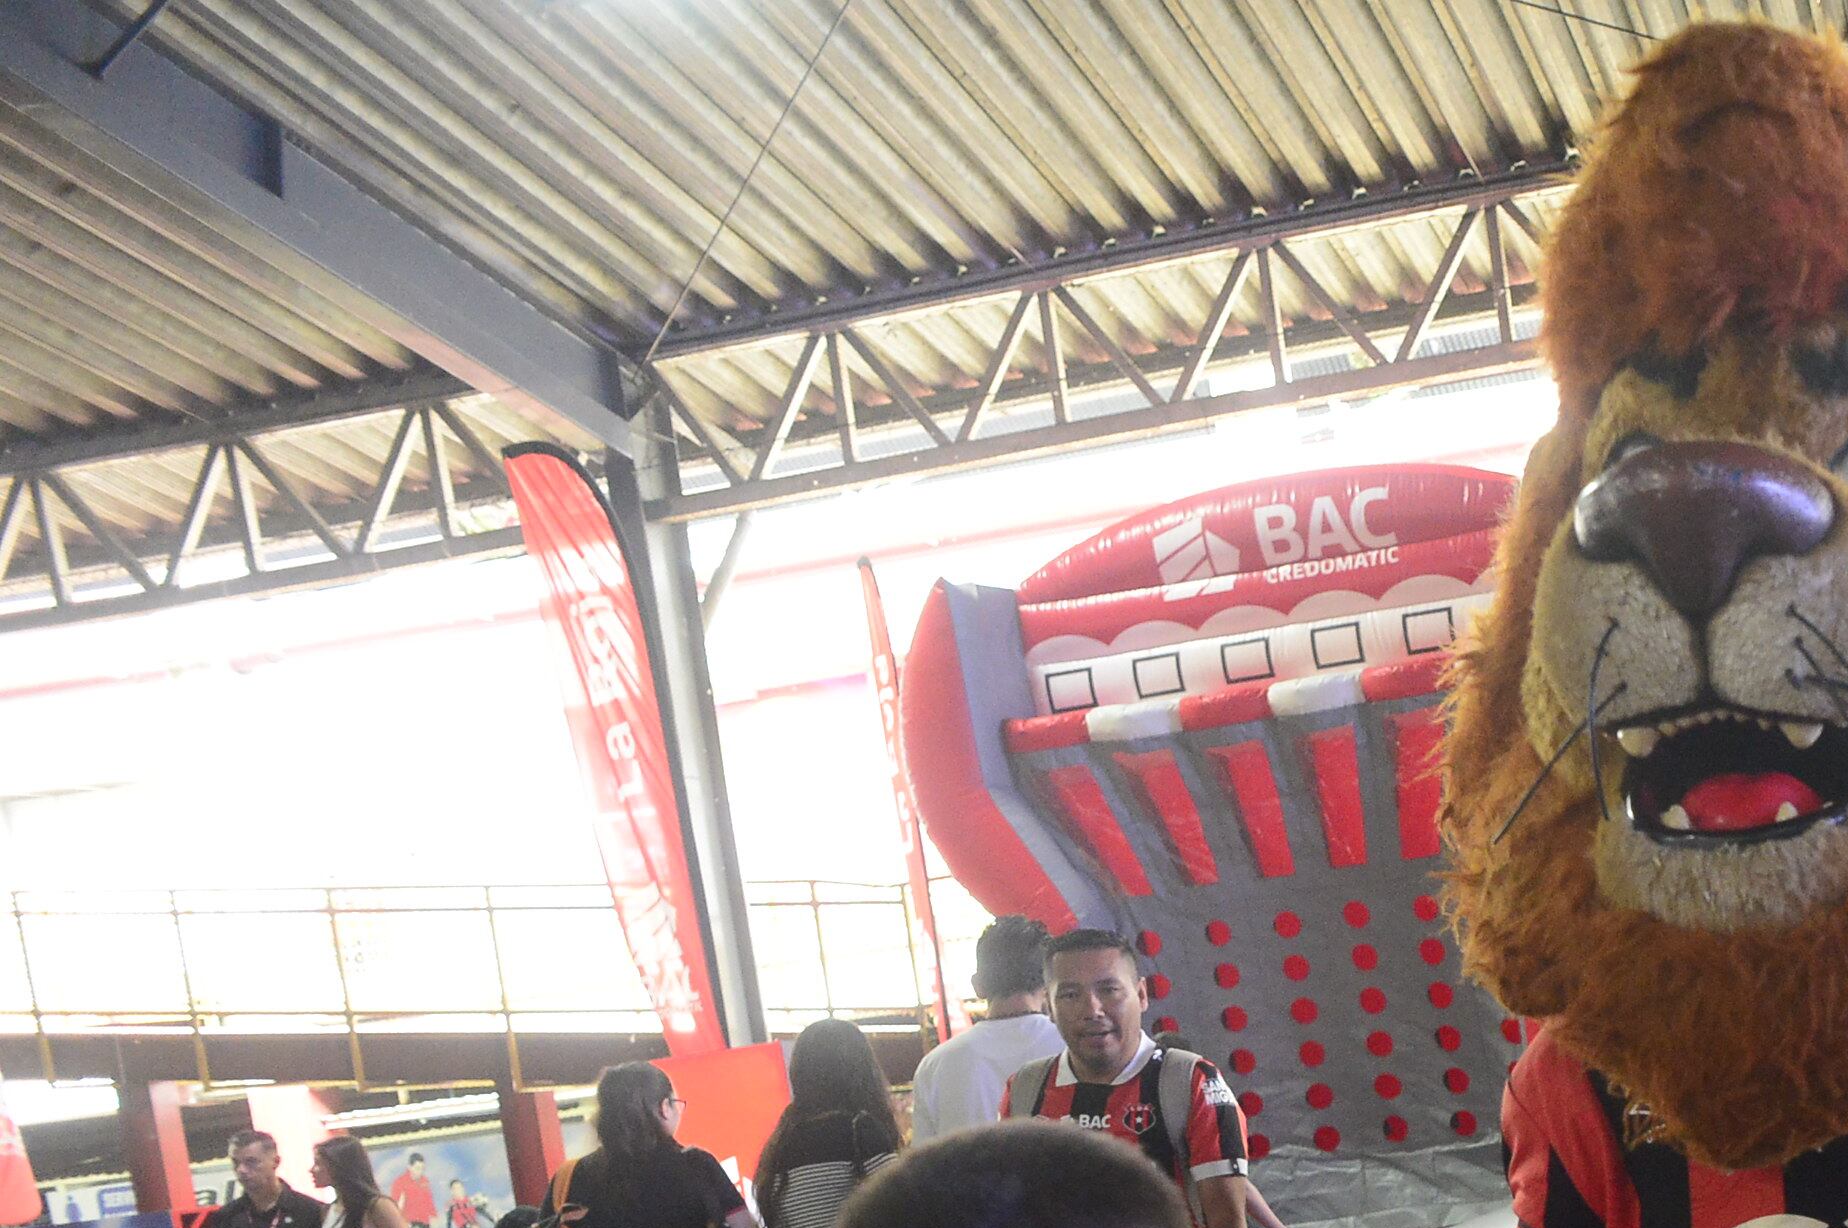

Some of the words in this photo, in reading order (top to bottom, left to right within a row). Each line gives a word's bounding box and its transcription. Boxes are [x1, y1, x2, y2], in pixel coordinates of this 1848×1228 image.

[1253, 487, 1398, 567] BAC
[1265, 547, 1400, 584] CREDOMATIC
[1078, 1114, 1111, 1129] BAC
